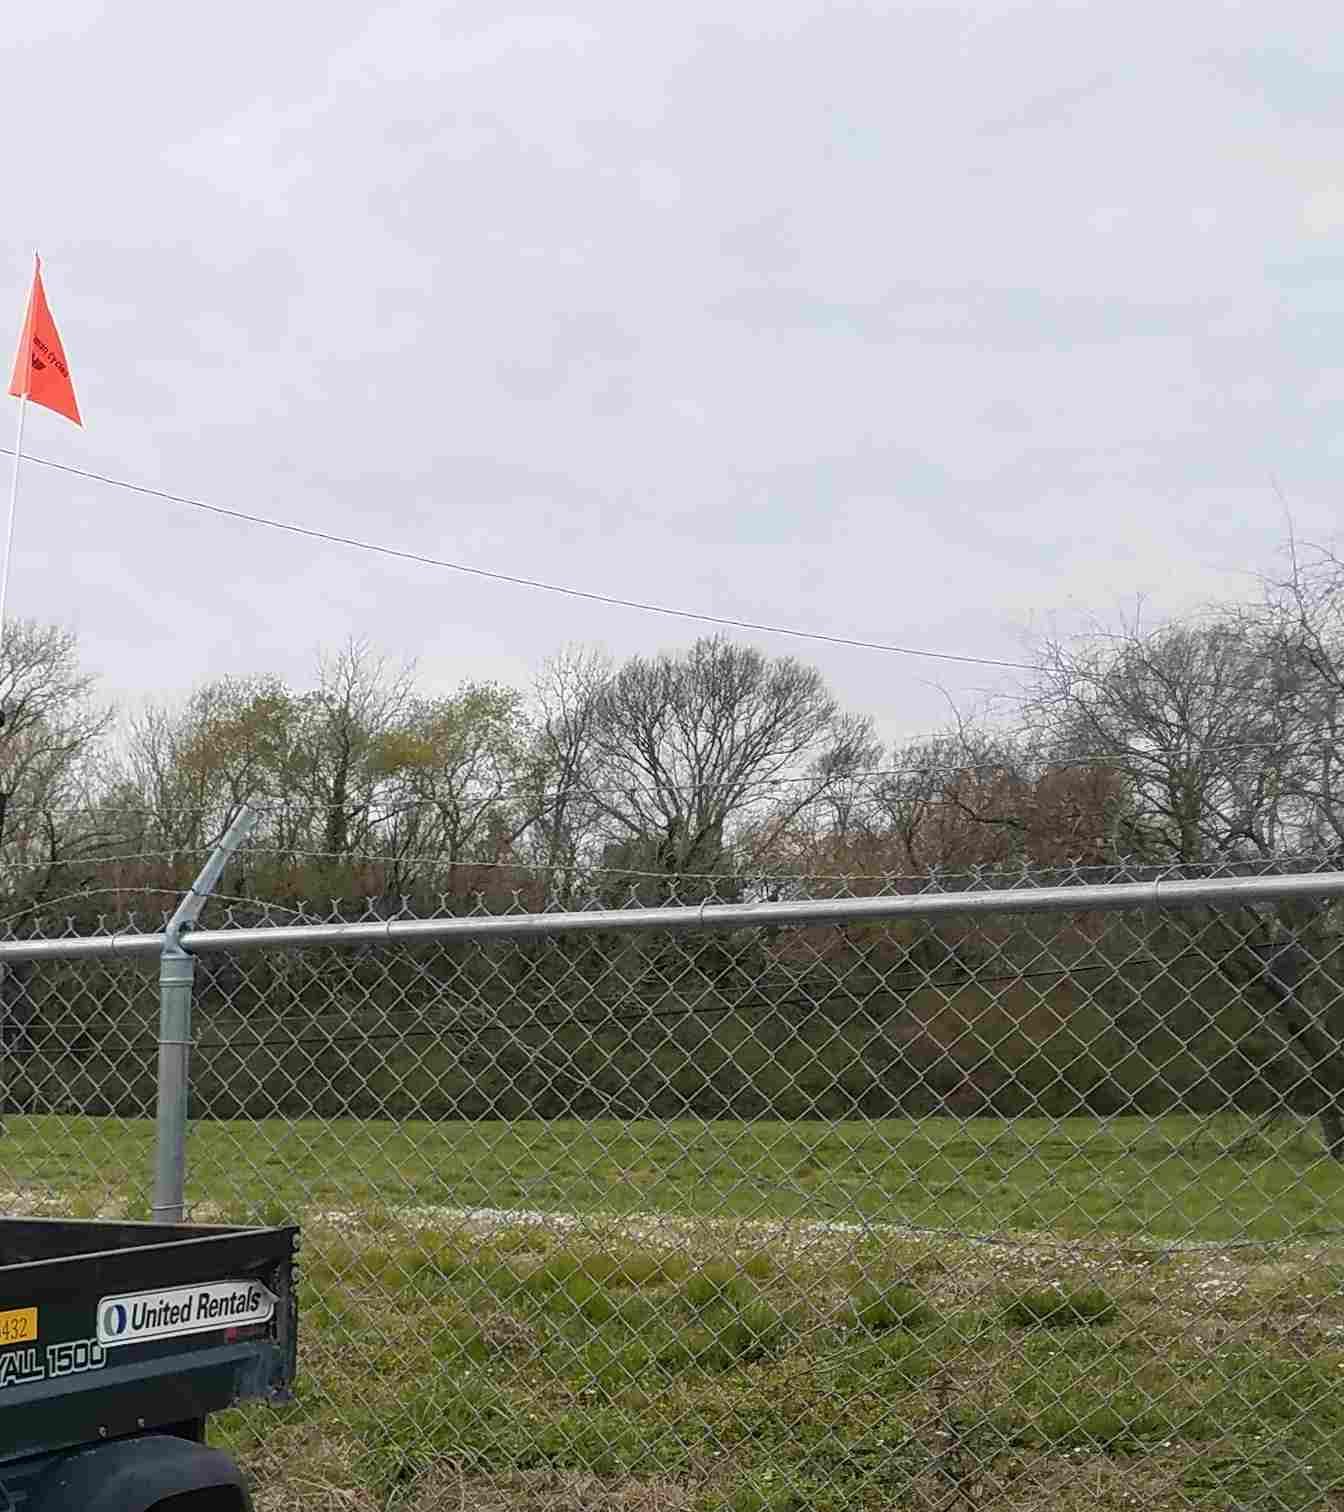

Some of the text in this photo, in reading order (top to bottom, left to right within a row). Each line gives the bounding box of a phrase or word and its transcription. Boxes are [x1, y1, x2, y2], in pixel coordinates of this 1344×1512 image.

[131, 1285, 262, 1331] United Rentals
[46, 1338, 108, 1377] 1500
